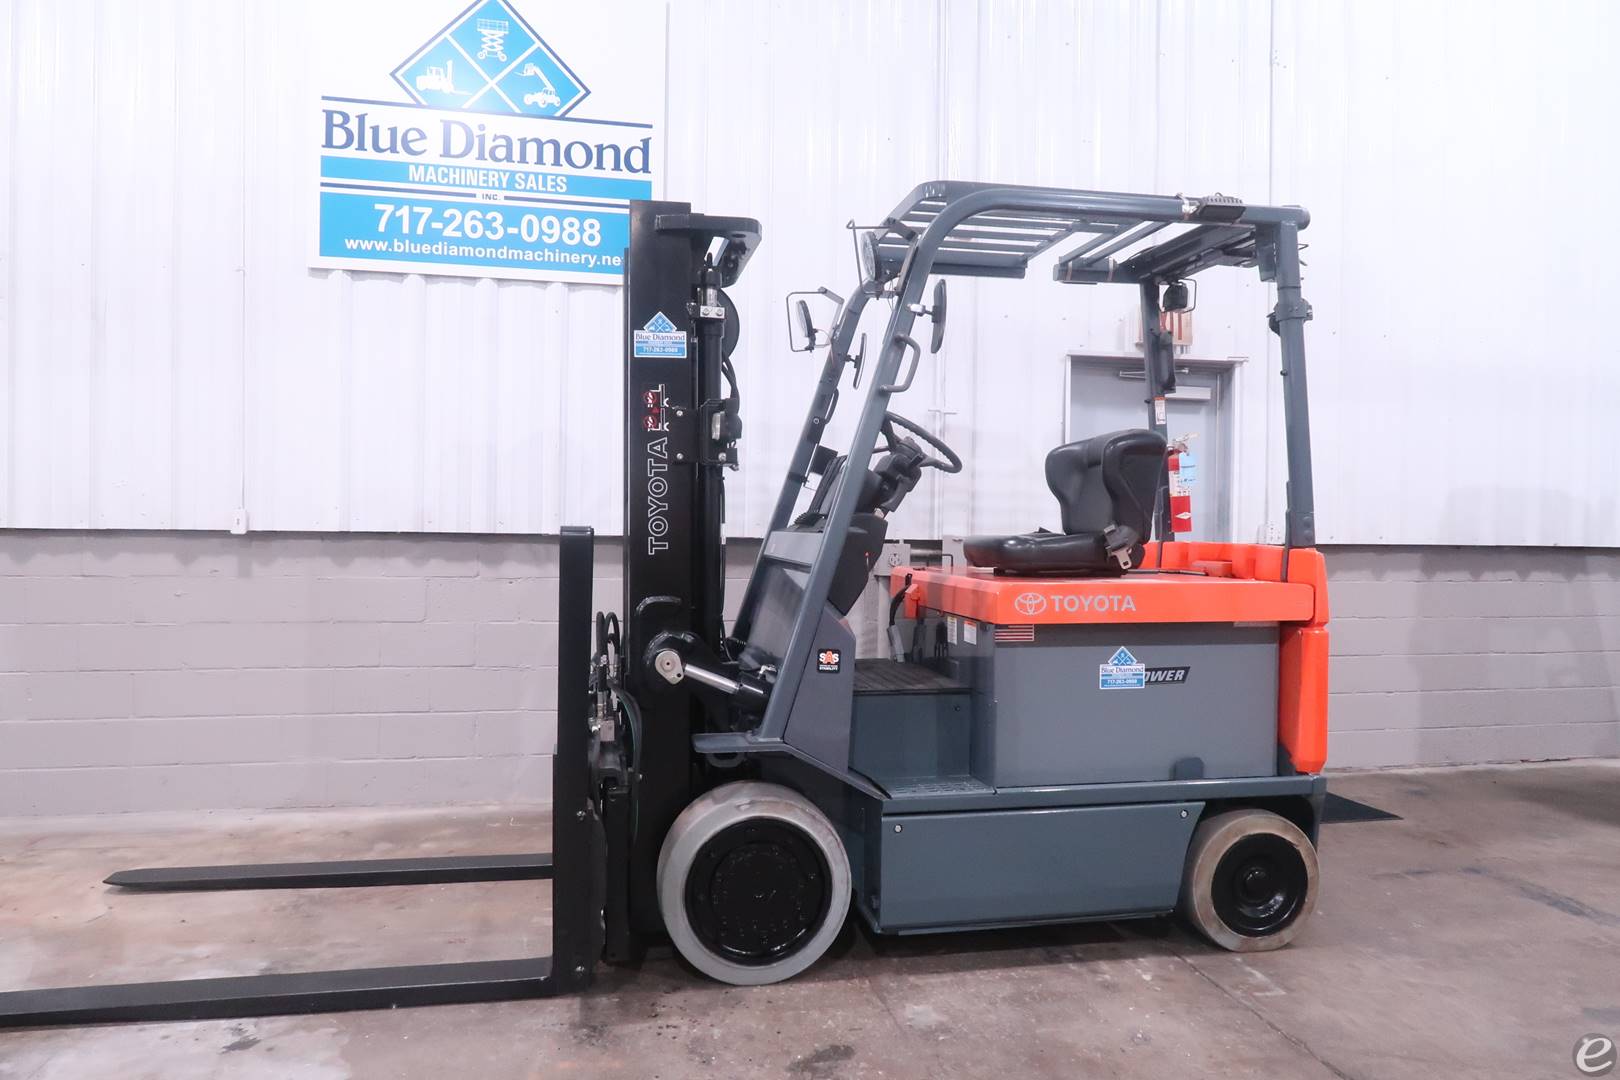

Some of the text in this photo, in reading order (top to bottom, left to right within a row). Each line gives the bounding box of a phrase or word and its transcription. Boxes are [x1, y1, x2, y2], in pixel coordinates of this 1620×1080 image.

[321, 109, 652, 174] Blue Diamond
[408, 164, 567, 193] MACHINERY SALES
[374, 203, 601, 247] 717-263-0988
[344, 238, 624, 267] www.bluediamondmachinery.ne
[648, 437, 668, 555] TOYOTA
[1051, 595, 1136, 611] TOYOTA
[819, 651, 839, 664] SAS
[1144, 670, 1184, 681] OWER
